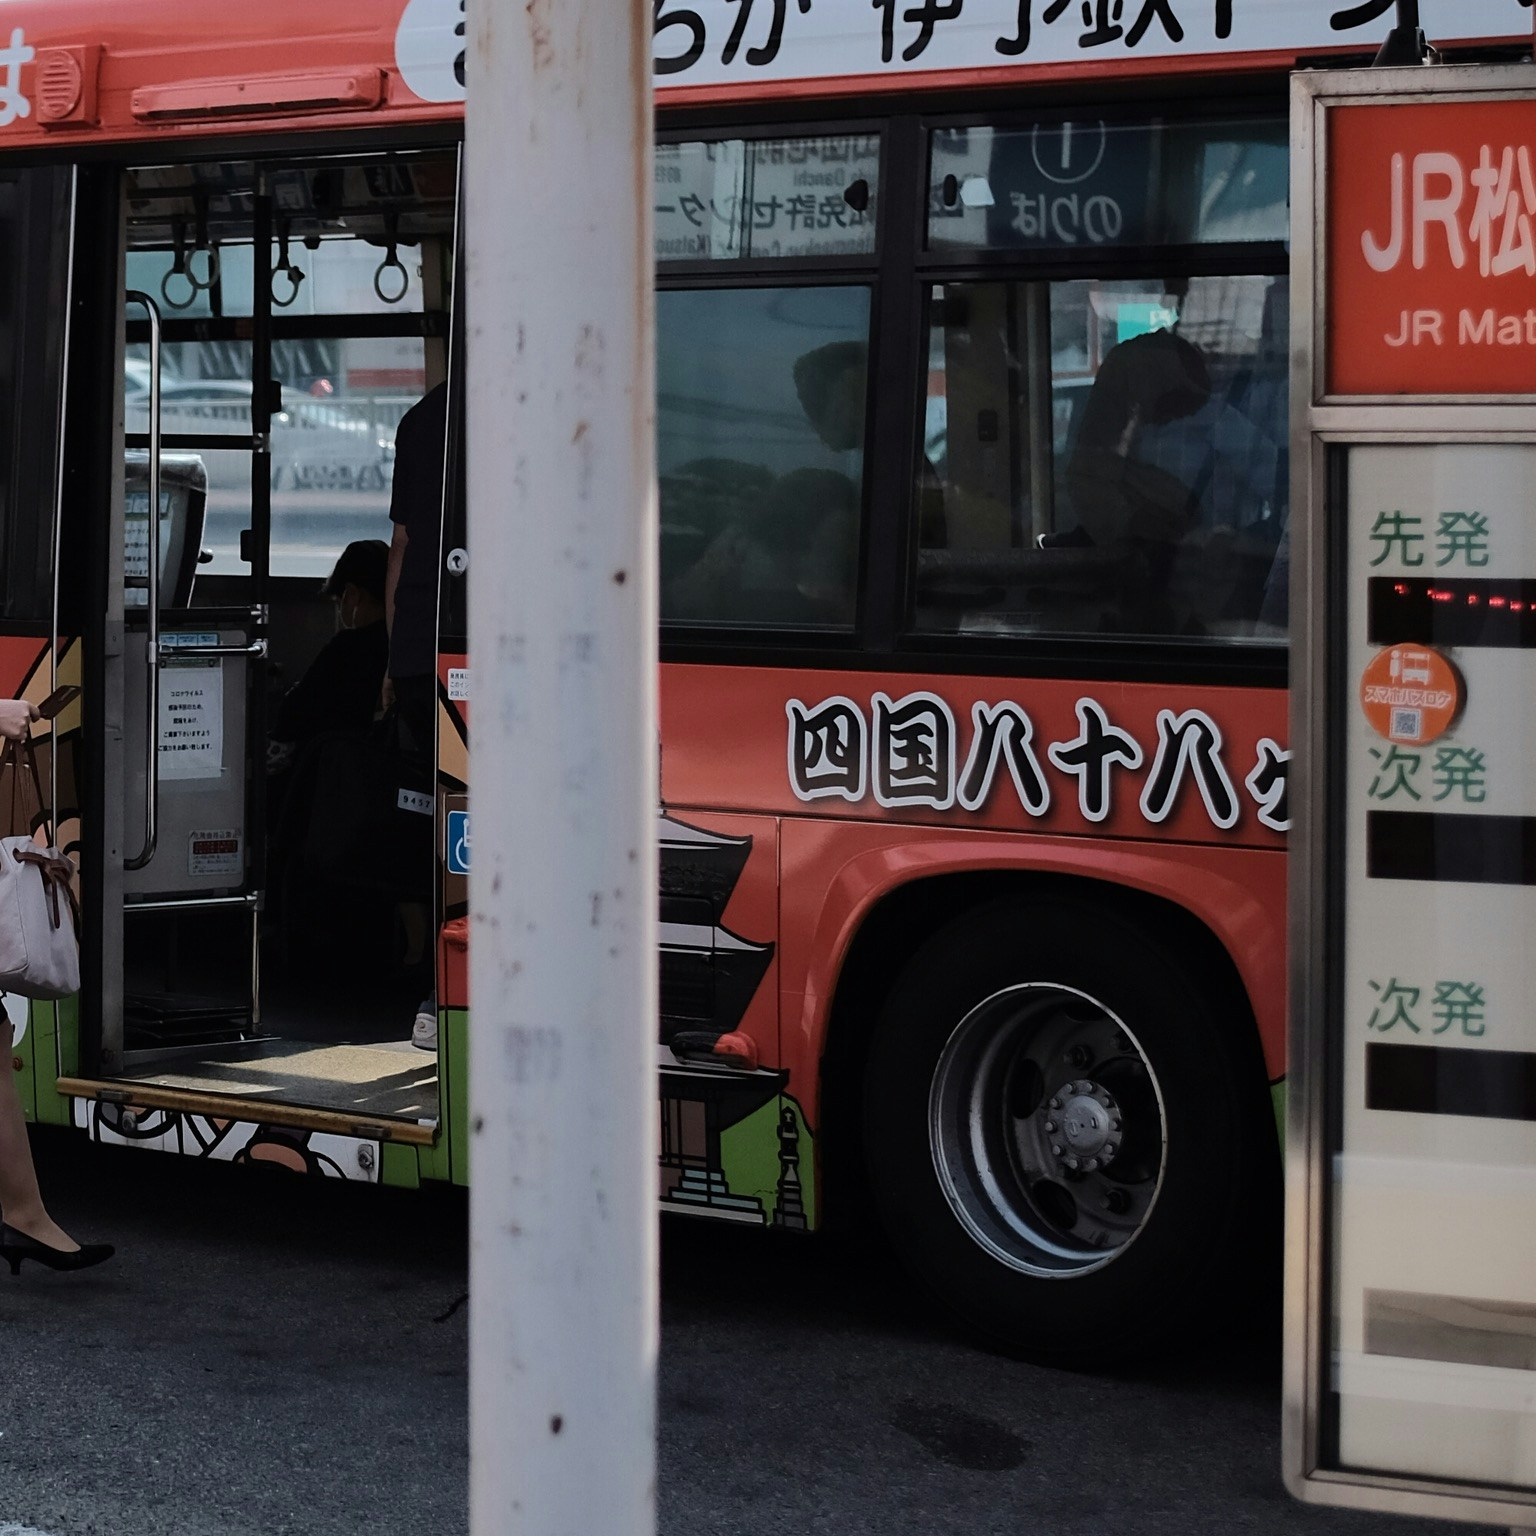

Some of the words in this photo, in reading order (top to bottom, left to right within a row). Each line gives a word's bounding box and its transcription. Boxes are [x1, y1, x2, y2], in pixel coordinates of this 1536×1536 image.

[1383, 310, 1443, 347] JR
[1369, 510, 1491, 568] 先発
[1365, 685, 1451, 709] スマホバスロケ
[1367, 746, 1487, 804] 次発
[403, 795, 432, 809] 9457
[1367, 977, 1487, 1039] 次発
